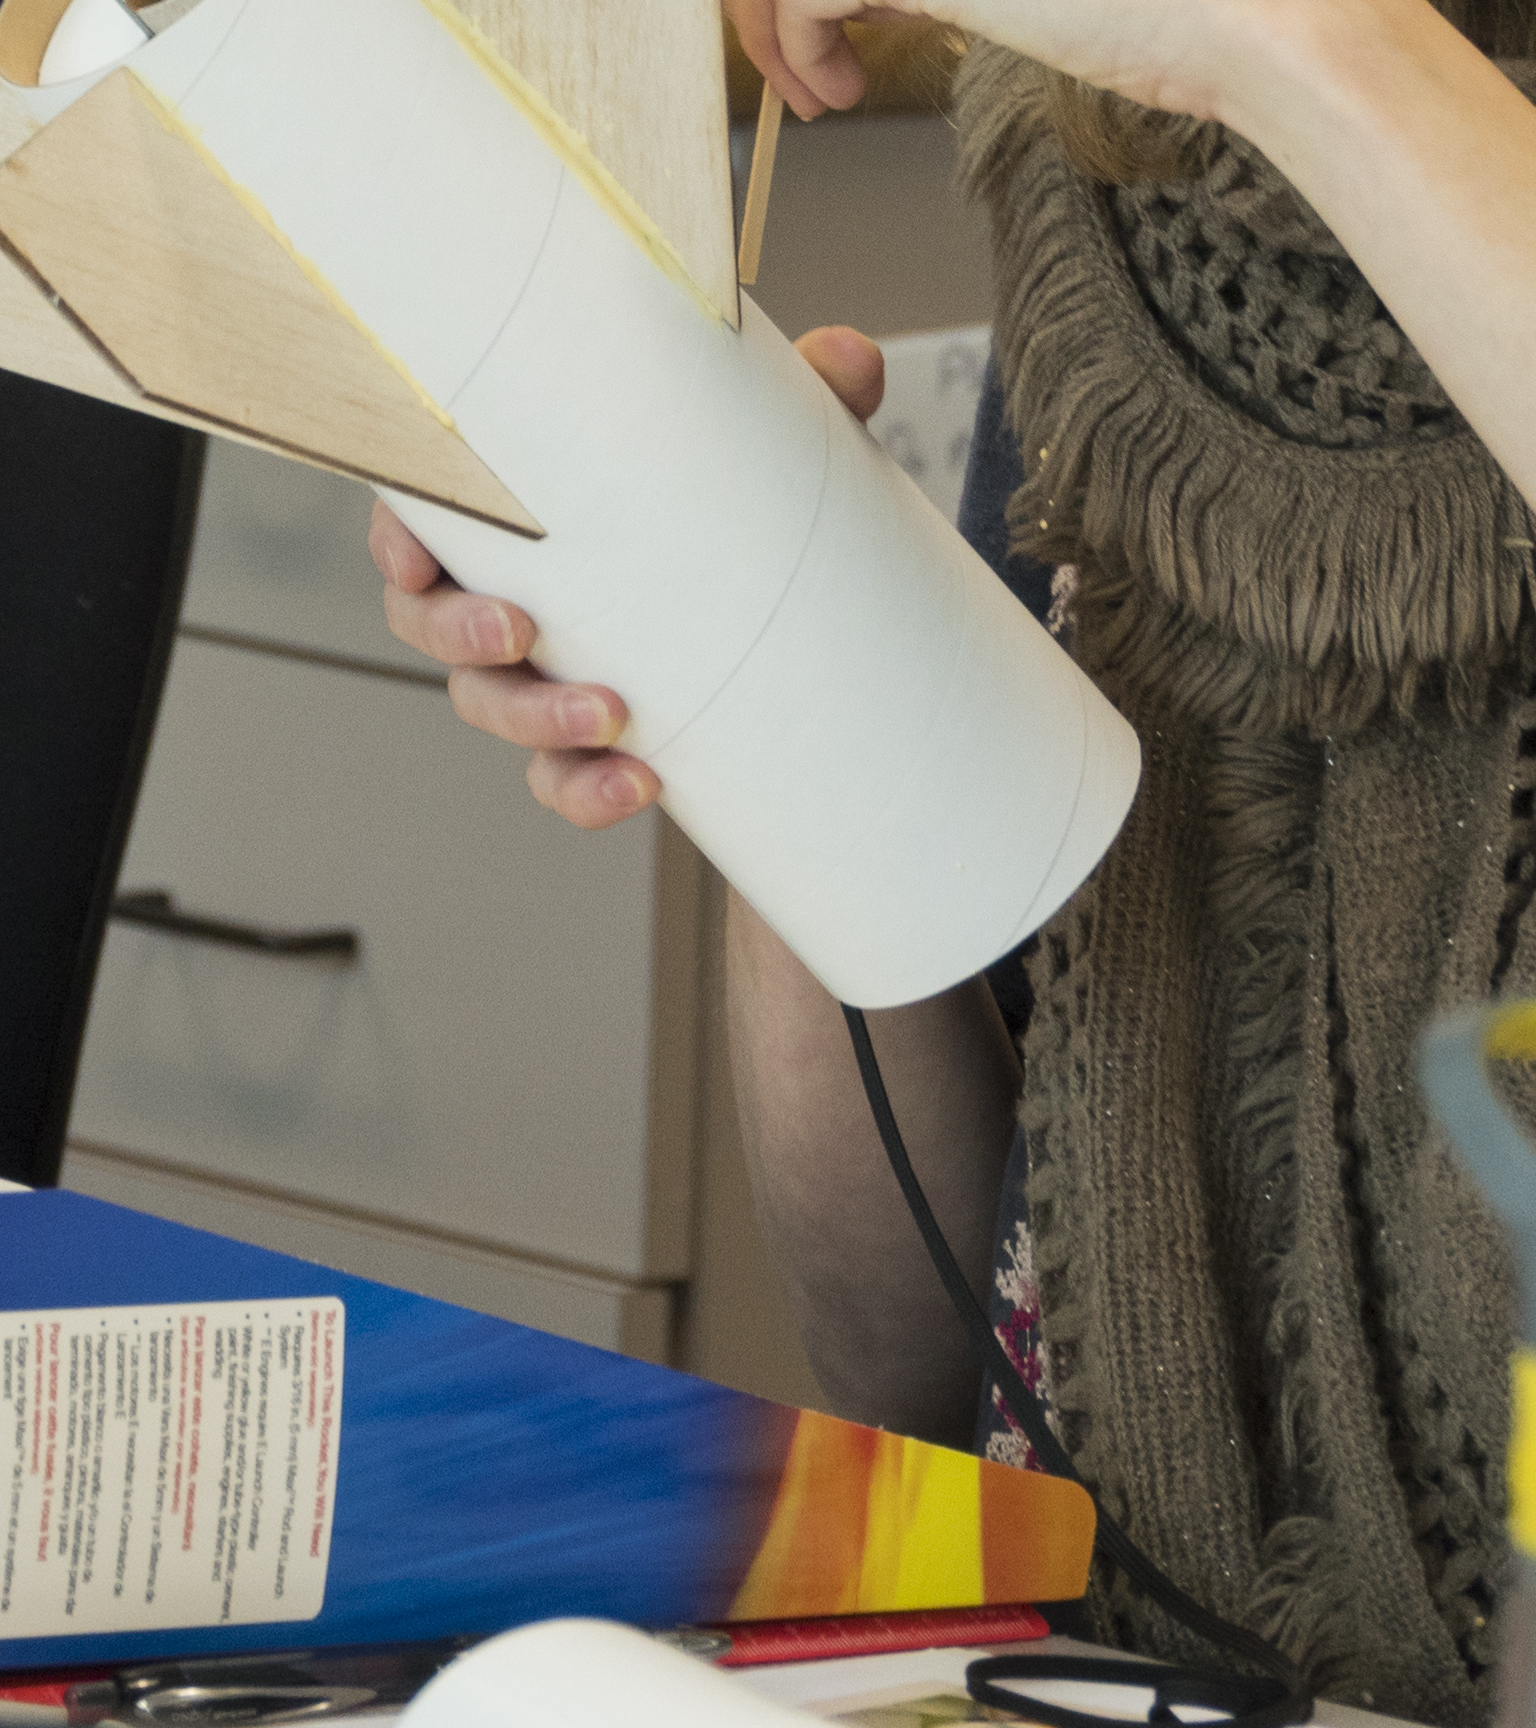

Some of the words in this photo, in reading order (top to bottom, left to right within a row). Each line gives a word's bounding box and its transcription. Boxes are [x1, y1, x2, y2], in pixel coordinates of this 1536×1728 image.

[277, 1324, 291, 1369] System
[322, 1328, 335, 1381] Launch
[320, 1383, 335, 1414] This
[315, 1466, 329, 1493] You
[313, 1493, 326, 1520] Will
[308, 1521, 324, 1558] Need
